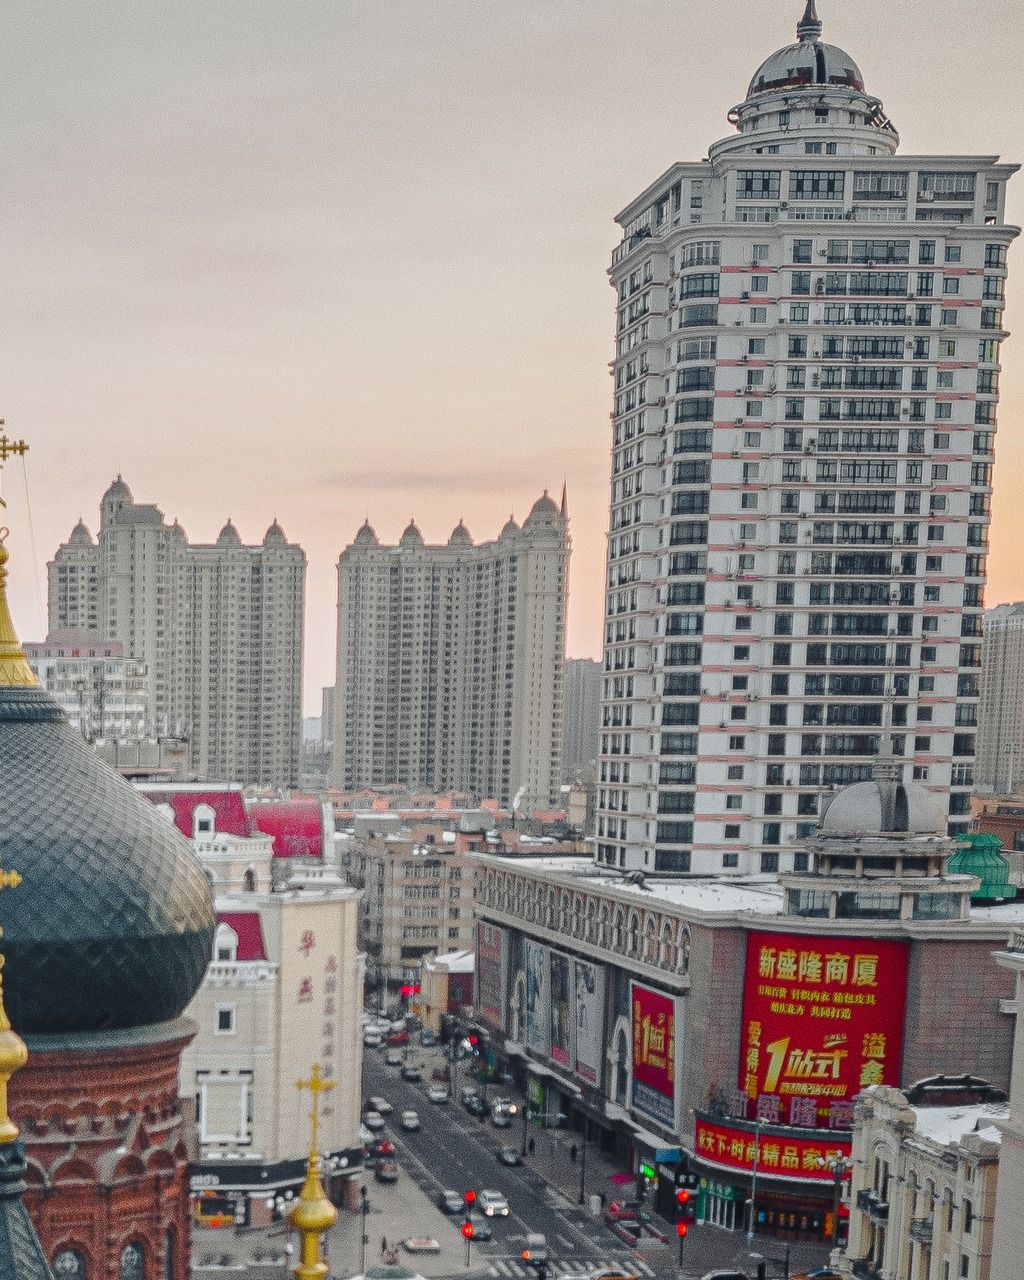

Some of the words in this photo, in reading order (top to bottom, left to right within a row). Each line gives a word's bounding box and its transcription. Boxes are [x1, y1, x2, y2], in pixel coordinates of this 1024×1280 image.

[759, 946, 879, 987] 新盛隆商厦
[763, 1037, 849, 1092] 1站式
